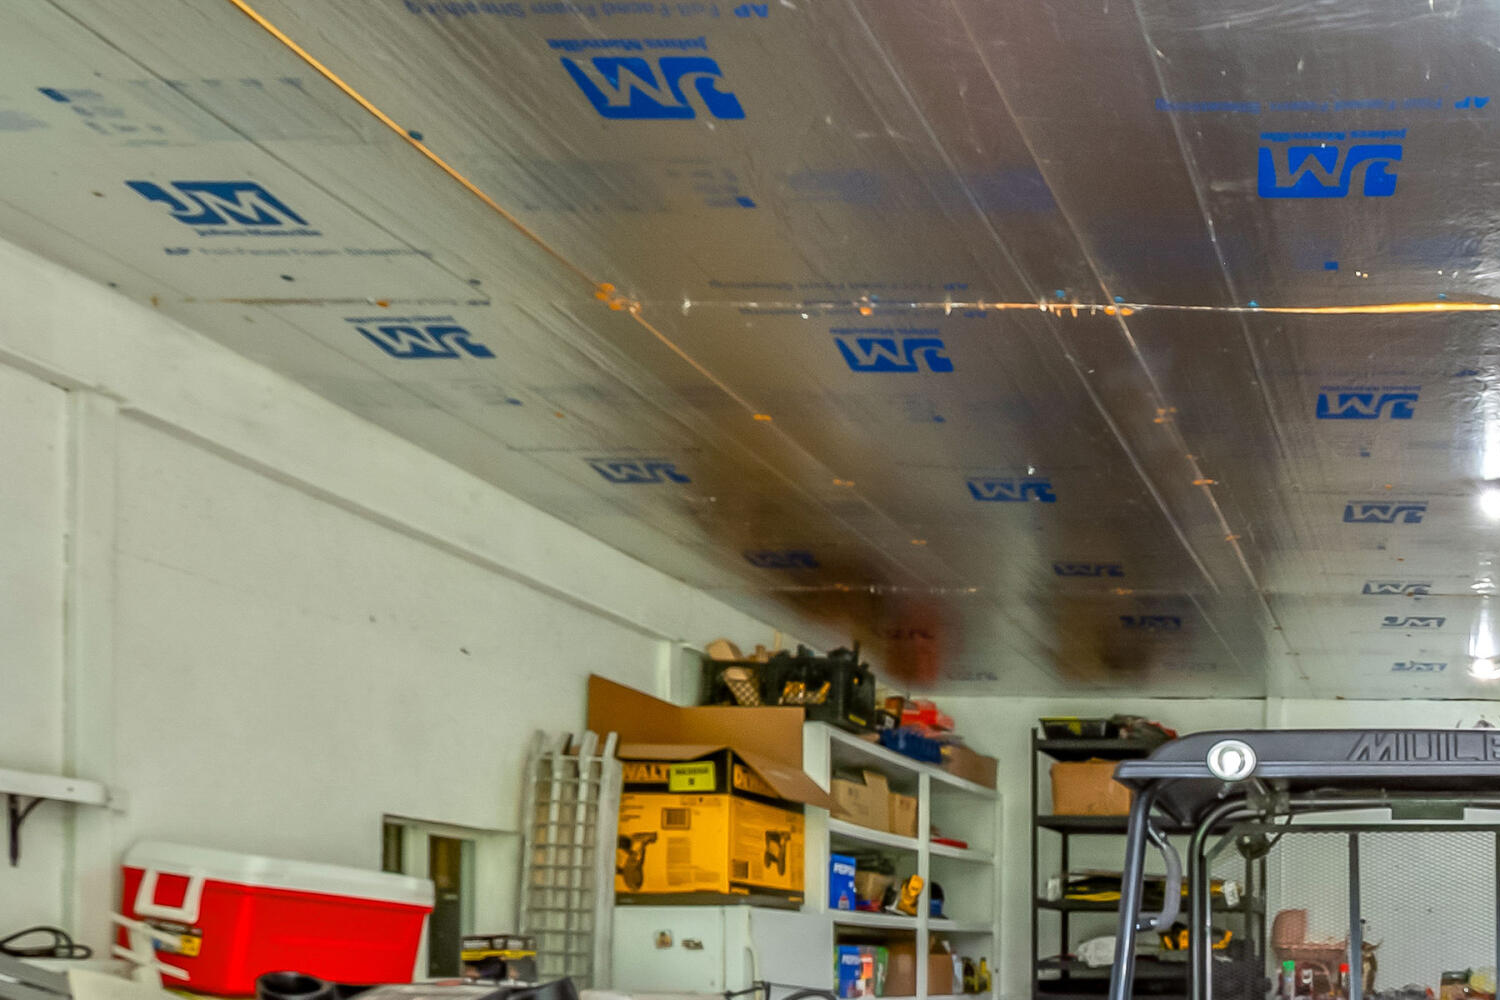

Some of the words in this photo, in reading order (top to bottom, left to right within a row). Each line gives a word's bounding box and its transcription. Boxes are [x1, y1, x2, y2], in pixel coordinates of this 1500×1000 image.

[733, 4, 769, 18] AP
[561, 57, 745, 119] JM
[1454, 97, 1490, 109] AP
[1258, 144, 1402, 198] JM
[125, 181, 308, 225] JM
[356, 325, 494, 358] JM
[836, 338, 953, 373] JM
[1317, 393, 1418, 419] JM
[1343, 504, 1426, 524] JM
